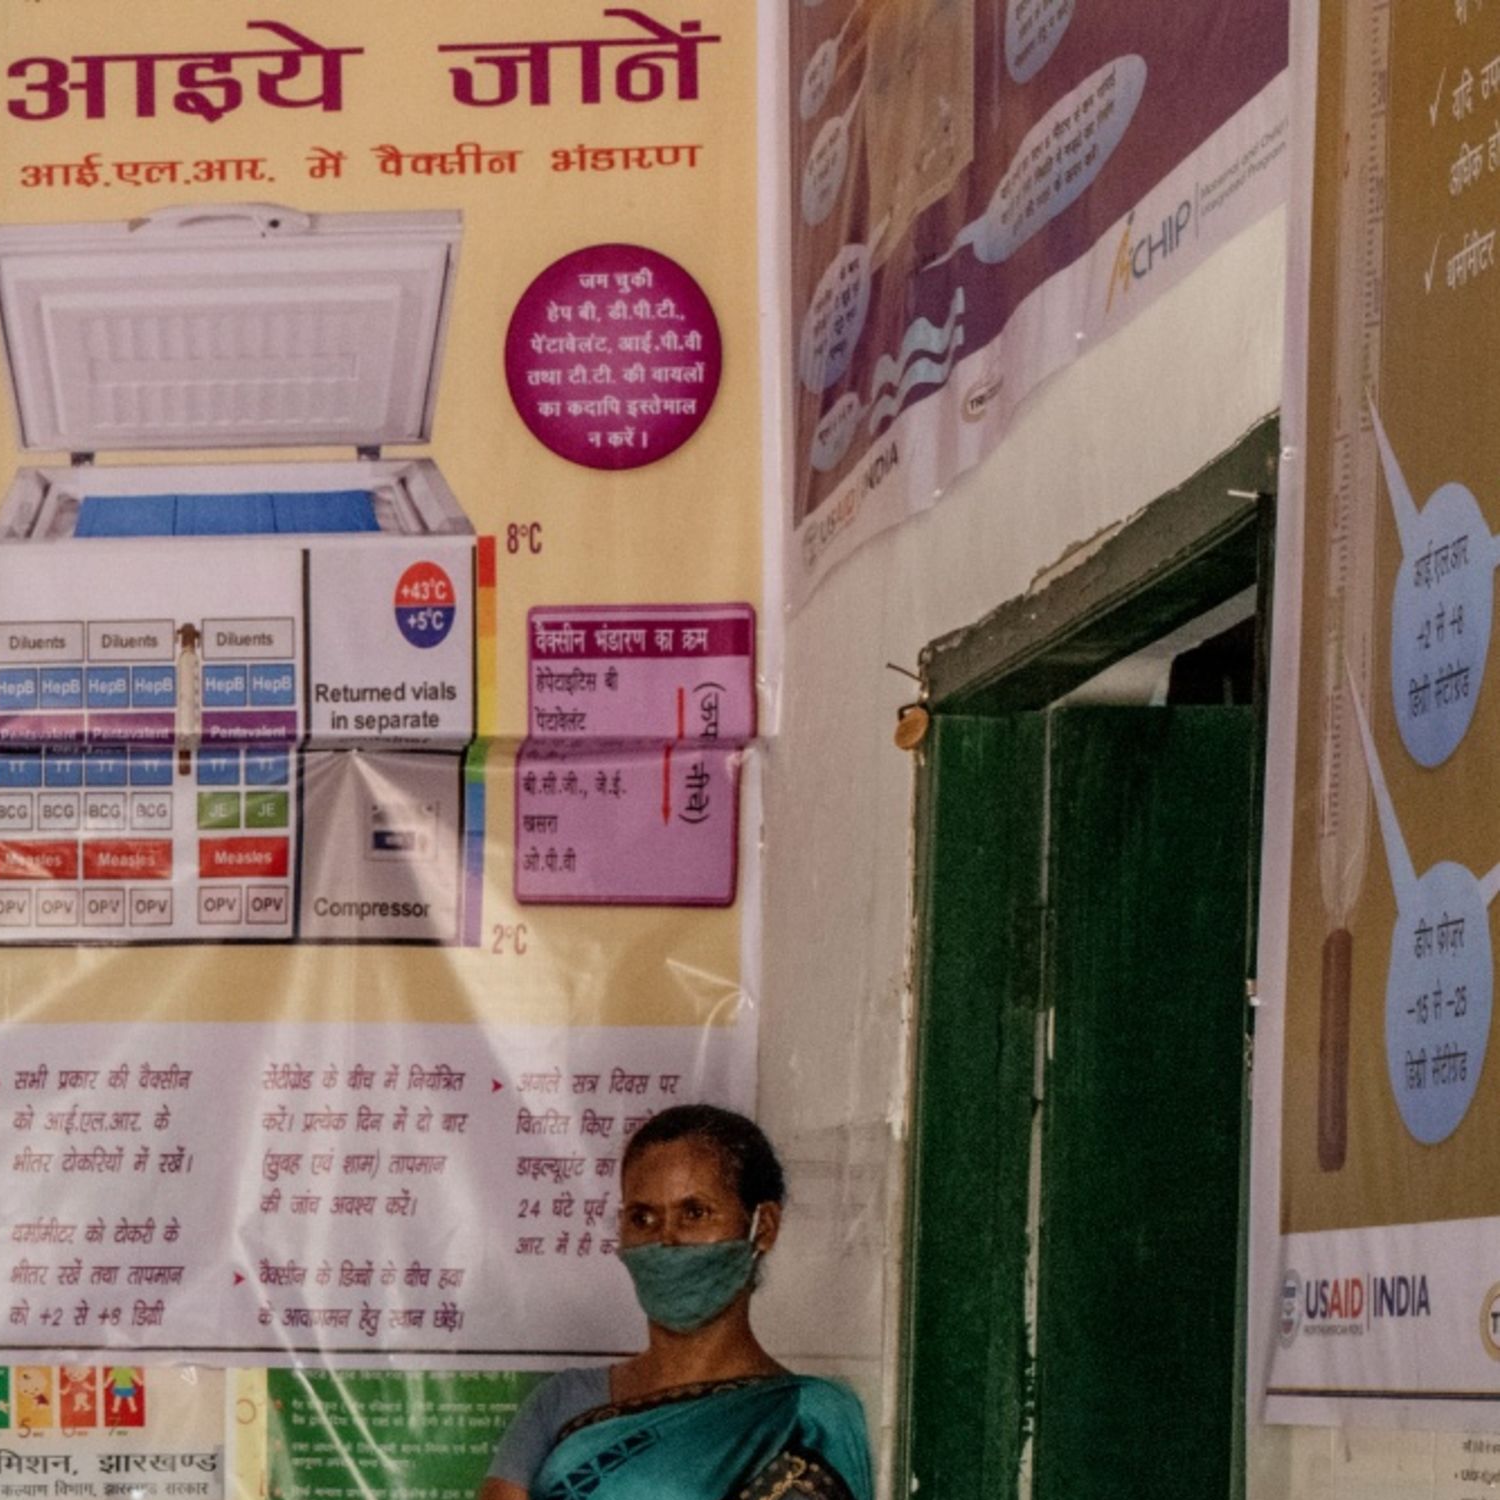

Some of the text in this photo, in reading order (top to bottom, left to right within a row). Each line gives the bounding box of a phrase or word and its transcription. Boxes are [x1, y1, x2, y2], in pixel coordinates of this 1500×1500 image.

[6, 7, 722, 124] आइये जानें
[21, 141, 704, 189] आई.एल.आर. में वैक्सीन भंडारण
[1448, 140, 1484, 197] अधिक
[1446, 227, 1497, 291] थर्मामीटर
[579, 266, 653, 294] जम चुकी
[546, 301, 572, 323] हेप
[527, 362, 646, 386] तथा की
[537, 393, 697, 418] का कदापि इस्तेमाल
[506, 521, 542, 554] 8°C
[9, 630, 274, 652] Diluents Diluents Diluents
[534, 621, 709, 653] वैक्सीन भंडारण का क्रम
[42, 678, 80, 697] HepB
[88, 677, 126, 696] HepB
[134, 676, 173, 695] HepB
[205, 675, 244, 694] HepB
[253, 674, 292, 693] HepB
[315, 682, 457, 704] Returned vials
[210, 722, 287, 740] Pentavalent
[331, 711, 440, 737] in separate
[42, 803, 74, 820] BCG
[89, 803, 121, 820] BCG
[135, 802, 167, 819] BCG
[209, 802, 227, 819] JE
[257, 802, 275, 818] JE
[98, 848, 272, 869] Measles Measles
[41, 899, 74, 916] OPV
[87, 899, 120, 916] OPV
[135, 898, 168, 916] OPV
[204, 897, 236, 914] OPV
[251, 896, 283, 913] OPV
[314, 898, 430, 922] Compressor
[15, 1064, 193, 1092] सभी प्रकार की वैक्सीन
[12, 1105, 171, 1131] को के
[301, 1105, 469, 1133] प्रत्येक दिन में दो बार
[13, 1146, 150, 1173] भीतर टोकरियों में
[329, 1195, 377, 1216] अवश्य
[518, 1199, 540, 1218] 24
[1304, 1273, 1432, 1320] USAID INDIA
[99, 1452, 219, 1475] झारखण्ड
